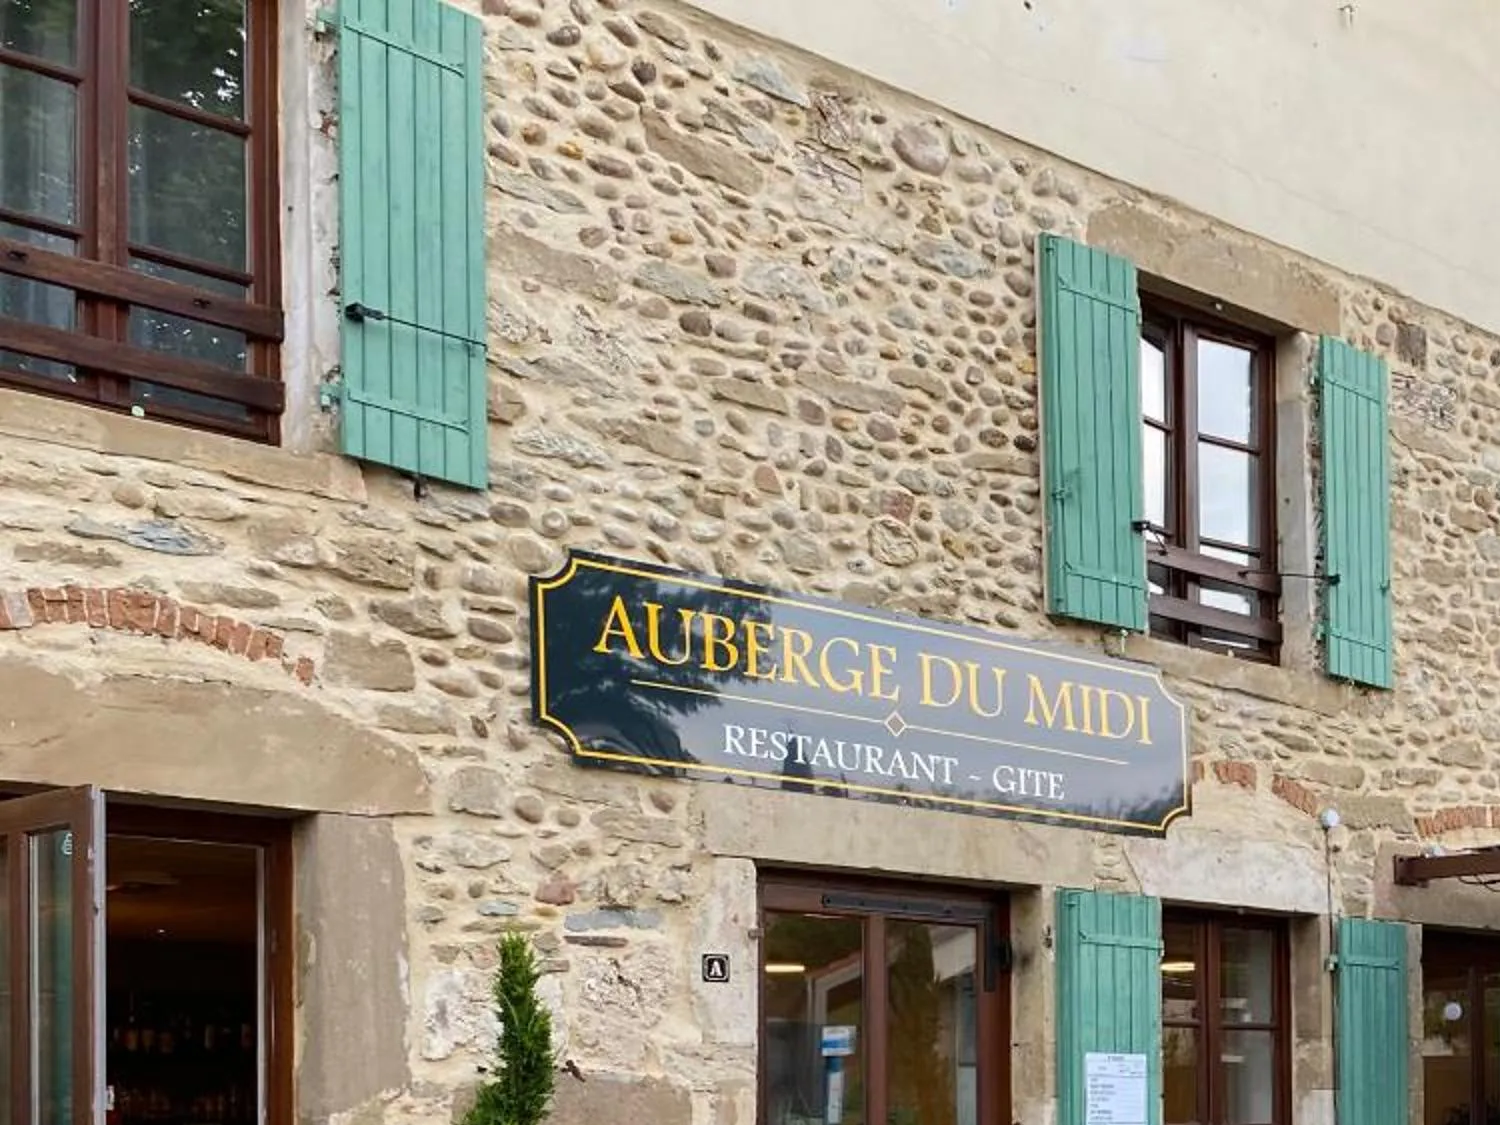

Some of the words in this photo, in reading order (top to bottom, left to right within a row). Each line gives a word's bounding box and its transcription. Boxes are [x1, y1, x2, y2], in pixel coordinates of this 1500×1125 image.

[592, 596, 901, 700] AUBERGE
[918, 653, 1007, 718] DU
[1024, 676, 1153, 745] MIDI
[723, 724, 959, 785] RESTAURANT
[993, 765, 1065, 800] GITE
[710, 960, 723, 977] A
